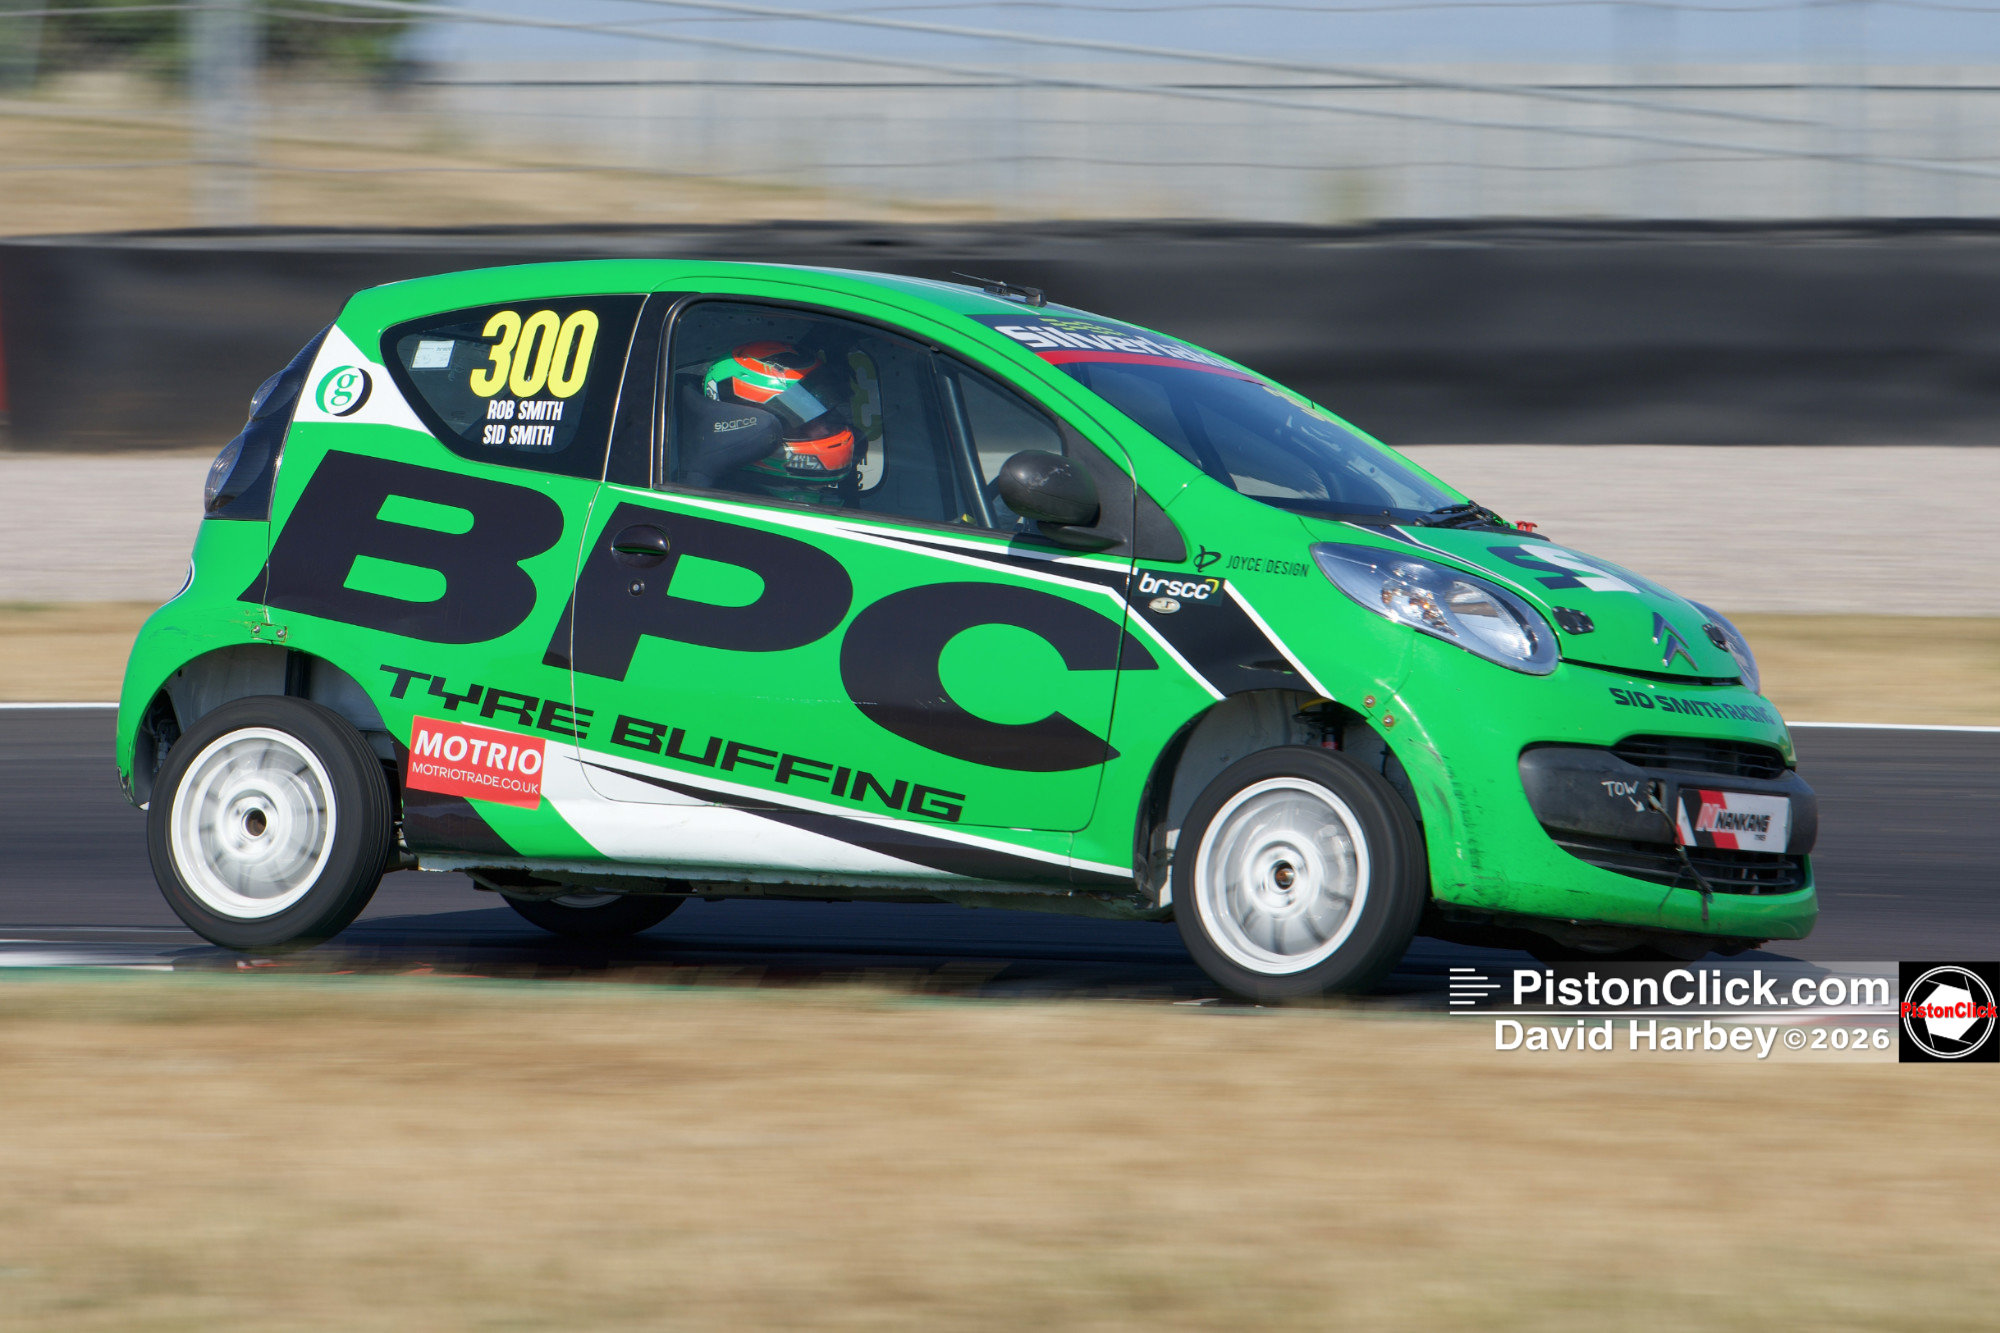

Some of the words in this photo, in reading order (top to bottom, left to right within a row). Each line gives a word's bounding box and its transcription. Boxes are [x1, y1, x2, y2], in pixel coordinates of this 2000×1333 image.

[470, 309, 599, 398] 300
[487, 400, 514, 420] ROB
[518, 401, 563, 421] SMITH
[714, 416, 757, 431] sparco
[483, 424, 505, 445] SID
[509, 425, 554, 445] SMITH
[1139, 572, 1211, 600] brscc
[238, 448, 1158, 772] BPC
[1609, 687, 1655, 709] SID
[1654, 694, 1728, 719] SMITH
[380, 664, 594, 739] TYRE
[610, 714, 966, 823] BUFFING
[413, 729, 542, 776] MOTRIO
[412, 762, 539, 795] MOTRIOTRADE.CO.UK
[1602, 780, 1639, 797] TOW
[1716, 811, 1770, 833] NANKANG
